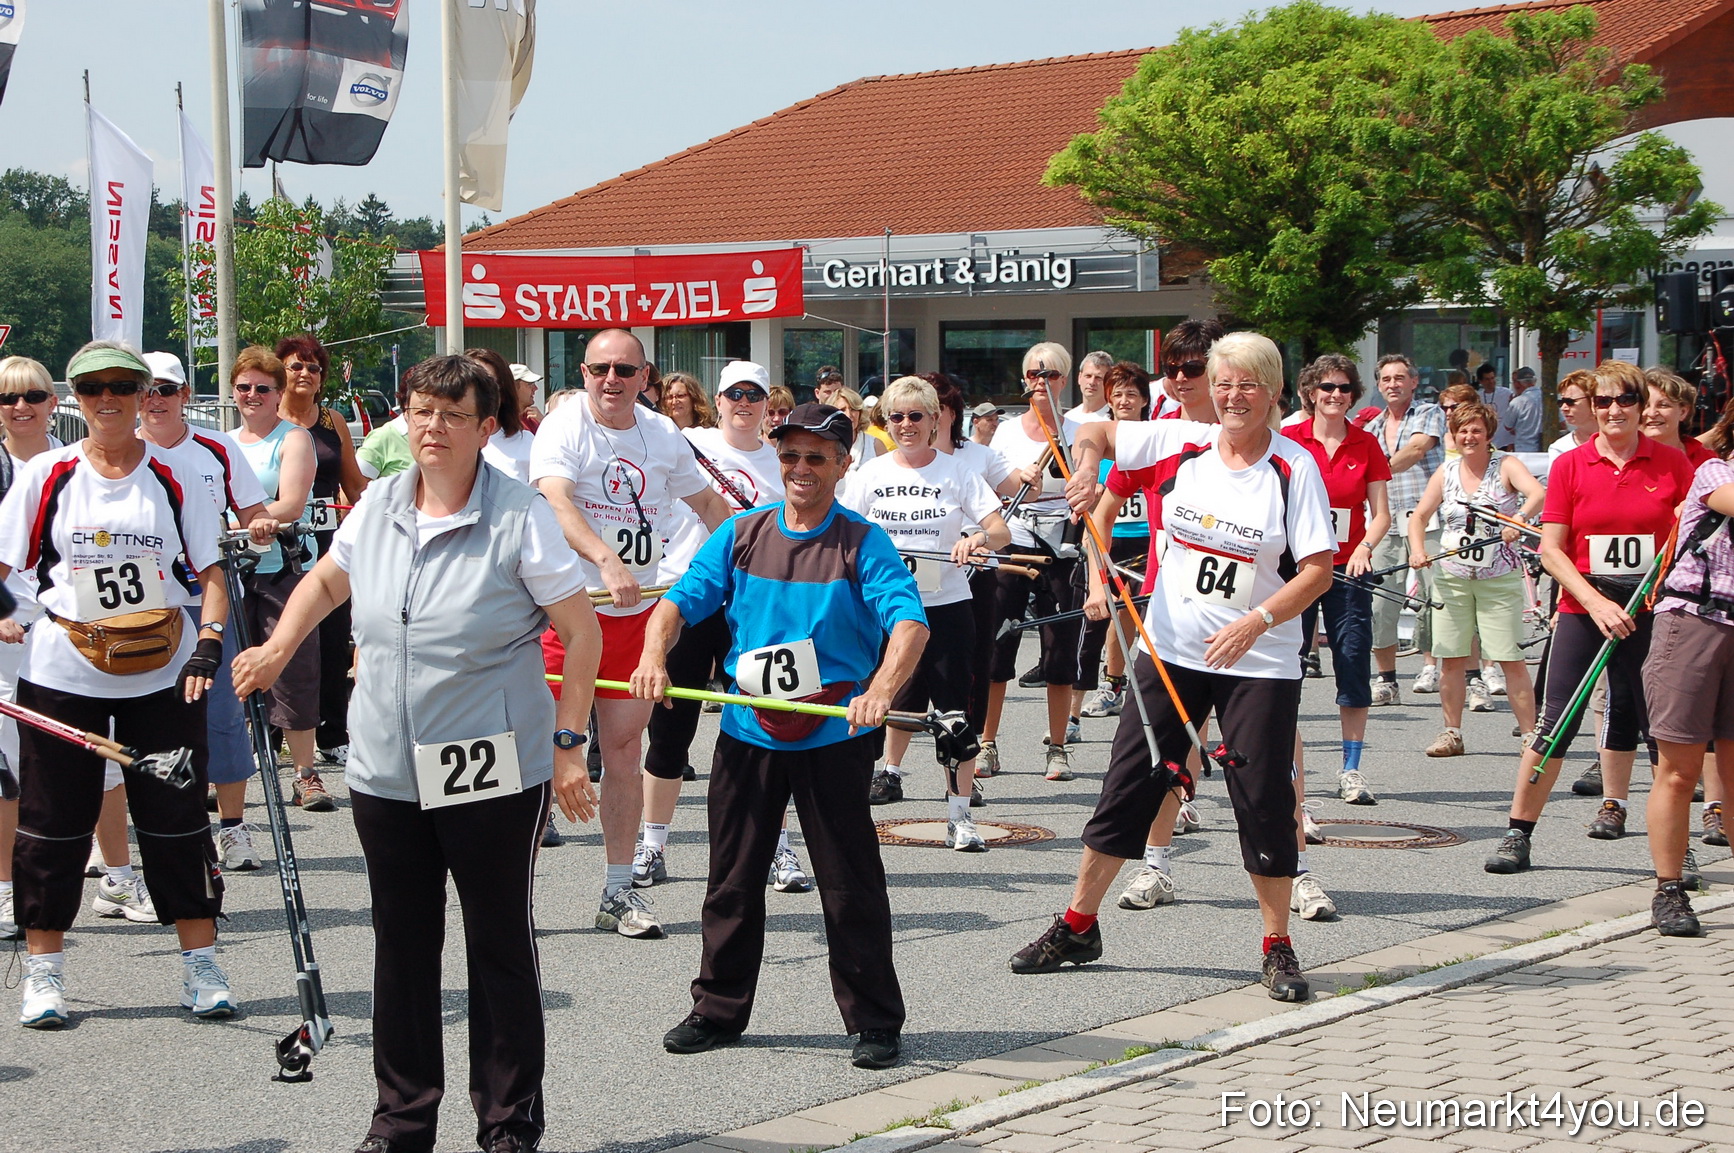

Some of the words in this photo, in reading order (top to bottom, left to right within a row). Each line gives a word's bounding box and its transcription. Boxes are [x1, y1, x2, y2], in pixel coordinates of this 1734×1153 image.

[317, 95, 329, 104] life
[352, 85, 386, 99] VOLVO
[822, 257, 945, 289] Gerhart
[954, 257, 976, 285] &
[985, 249, 1075, 289] Jänig
[514, 280, 731, 322] START+ZIEL
[874, 485, 942, 500] BERGER
[605, 513, 622, 522] Heck
[872, 507, 908, 522] OWER
[910, 507, 947, 521] GIRLS
[616, 528, 652, 567] 20
[914, 528, 941, 537] talking
[1604, 536, 1641, 568] 40
[94, 562, 145, 610] 53
[1196, 555, 1239, 600] 64
[754, 647, 800, 696] 73
[440, 739, 500, 797] 22
